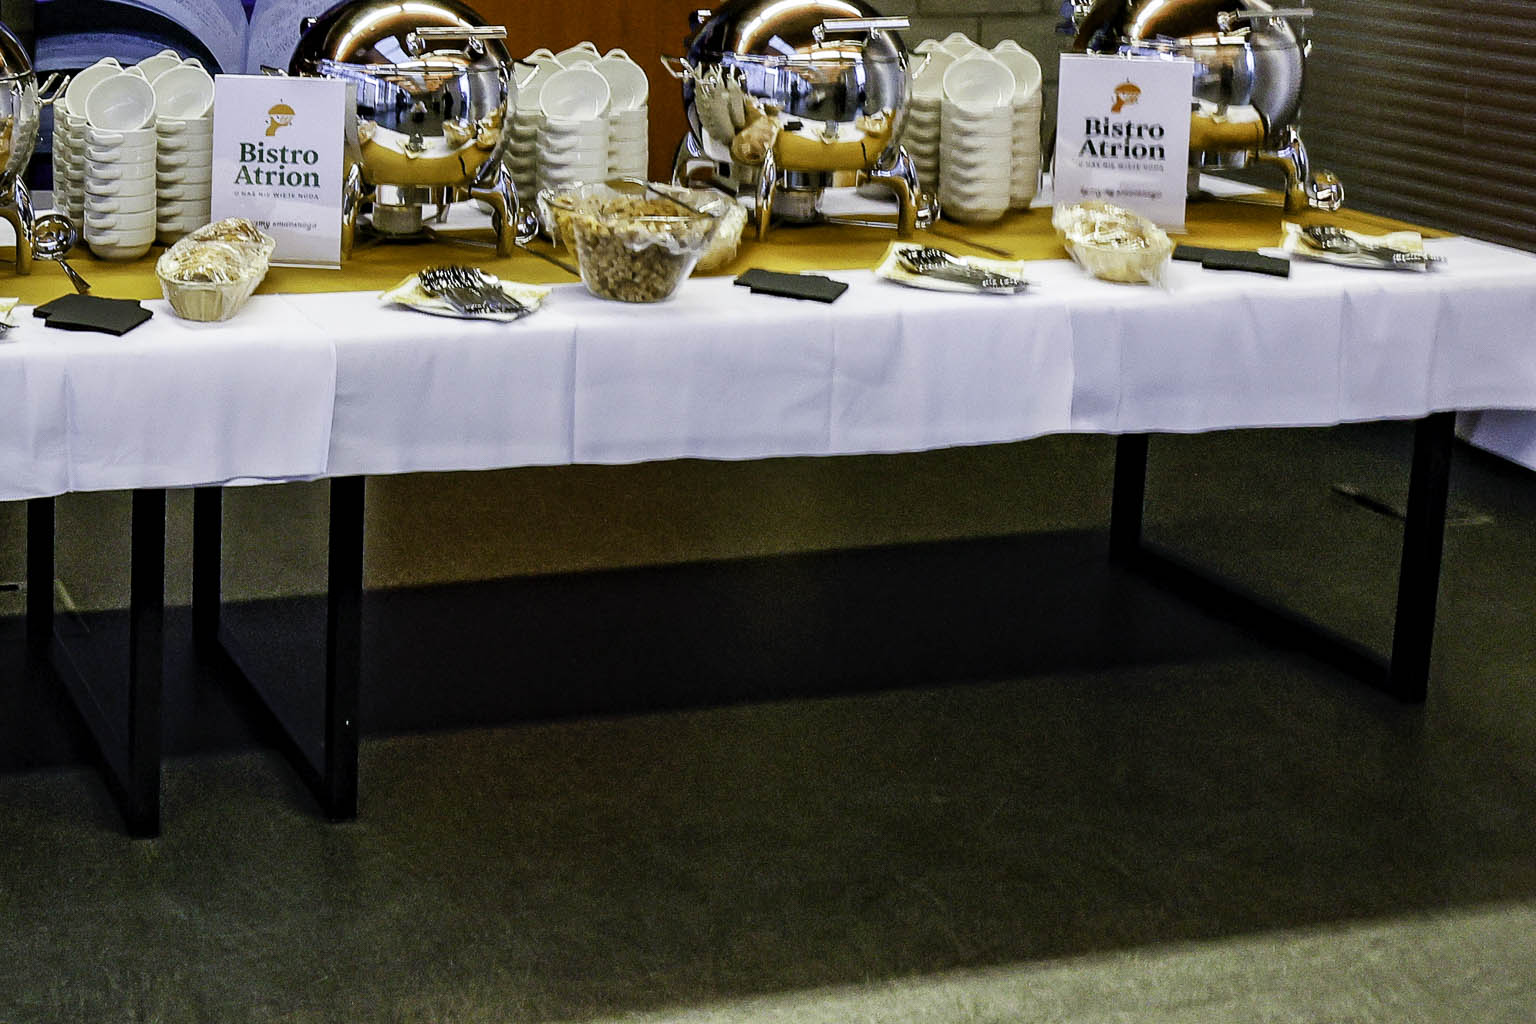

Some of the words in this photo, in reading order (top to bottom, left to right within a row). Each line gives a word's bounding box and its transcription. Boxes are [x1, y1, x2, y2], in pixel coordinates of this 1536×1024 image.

[1084, 116, 1165, 140] Bistro
[239, 142, 319, 165] Bistro
[1078, 136, 1165, 160] Atrion
[234, 165, 321, 189] Atrion
